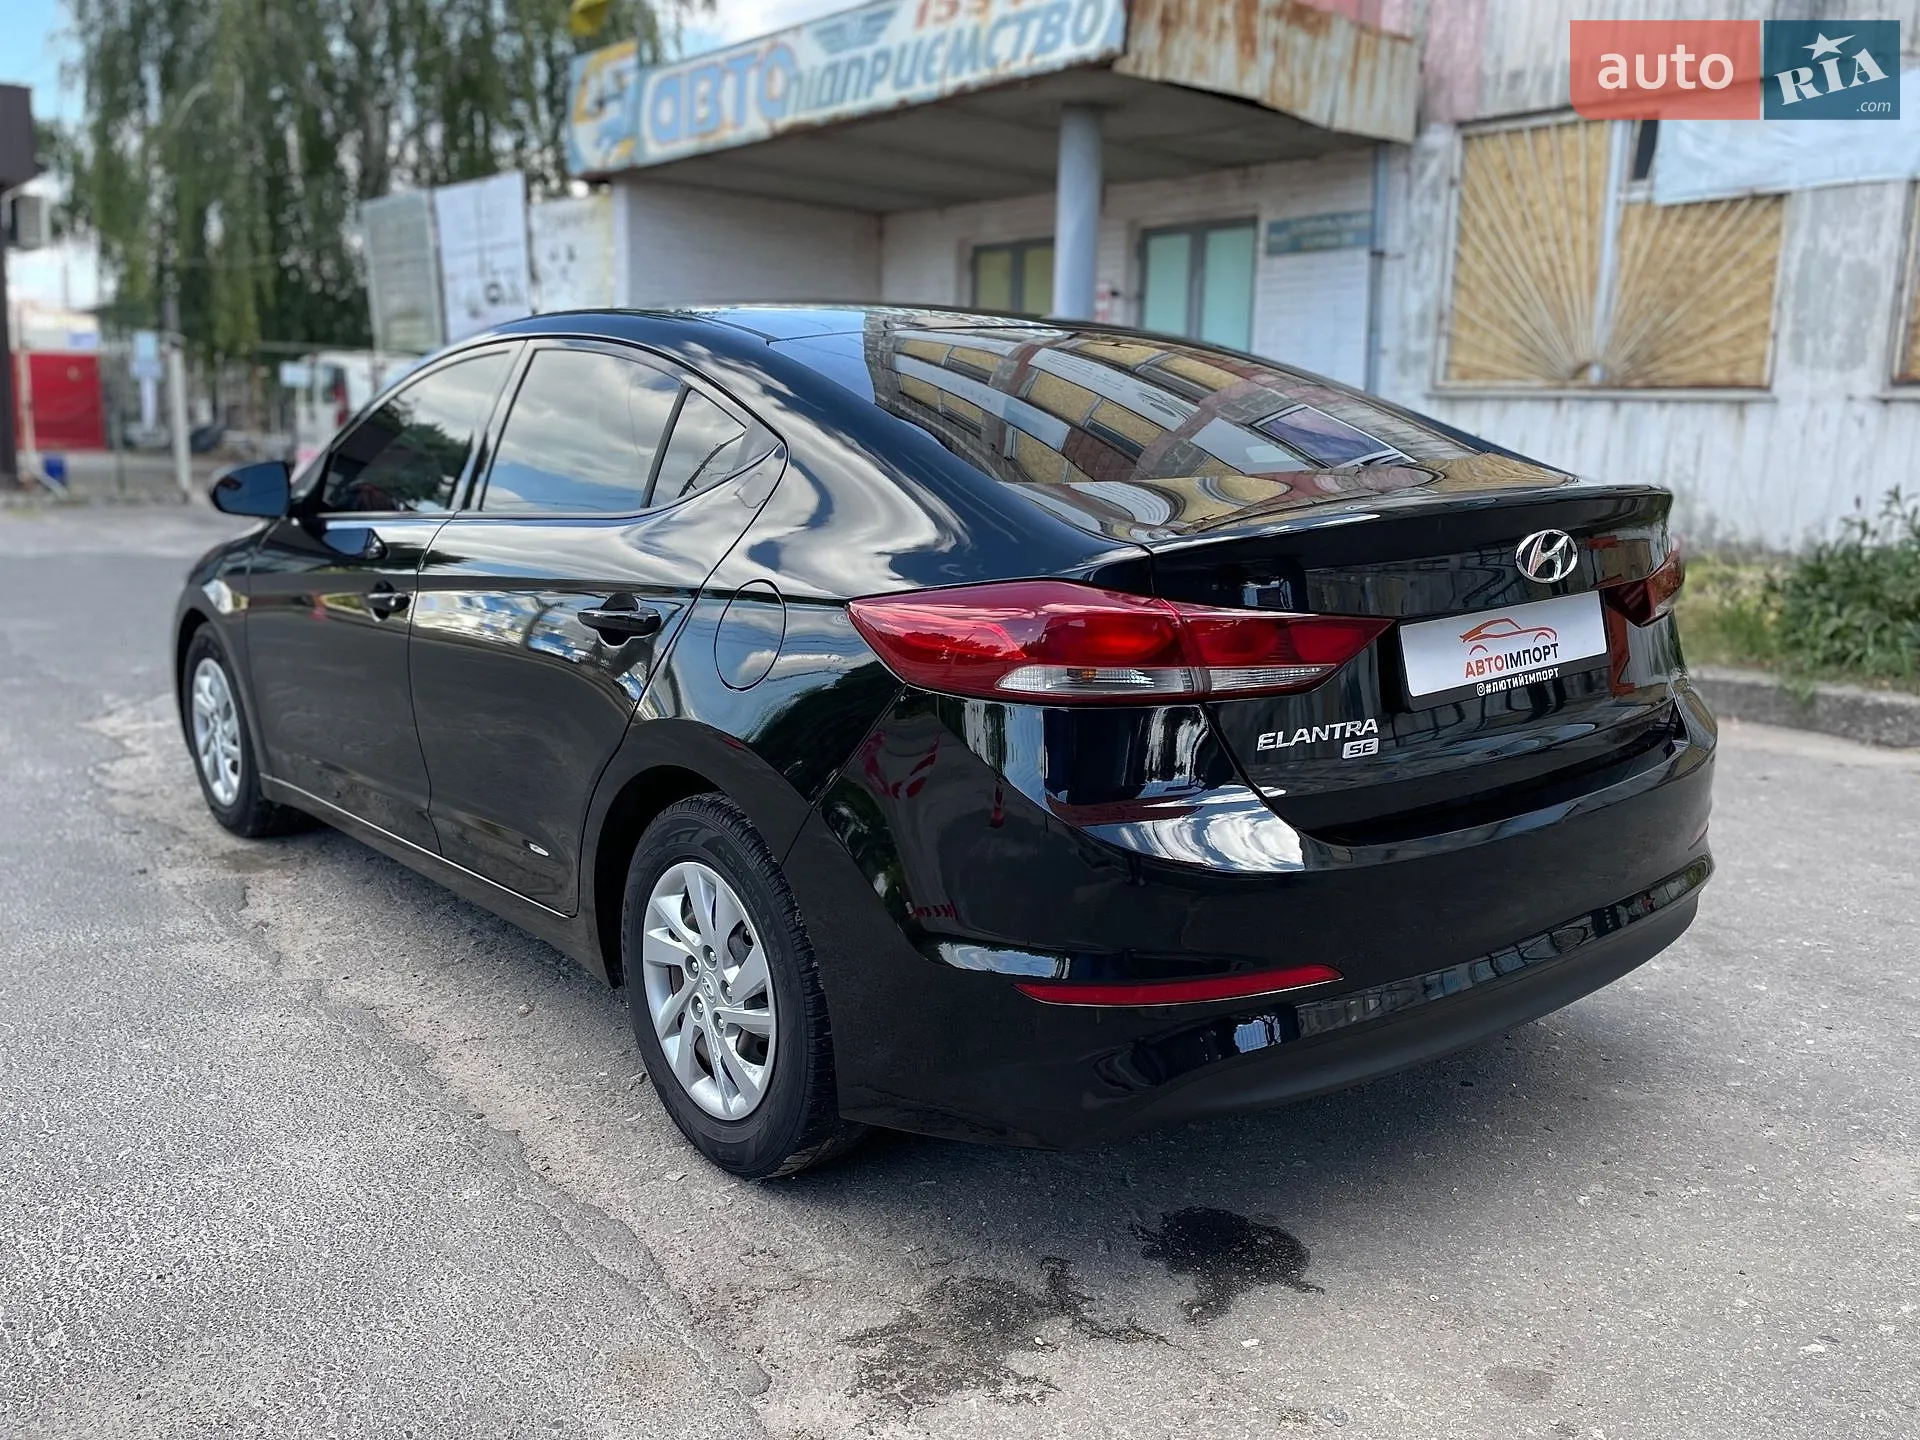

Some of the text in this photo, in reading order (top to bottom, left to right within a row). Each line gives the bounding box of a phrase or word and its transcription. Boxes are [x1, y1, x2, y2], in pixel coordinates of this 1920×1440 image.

[1465, 643, 1559, 678] АВТОІМПОРТ
[1257, 718, 1379, 751] ELANTRA
[1346, 740, 1376, 757] SE
